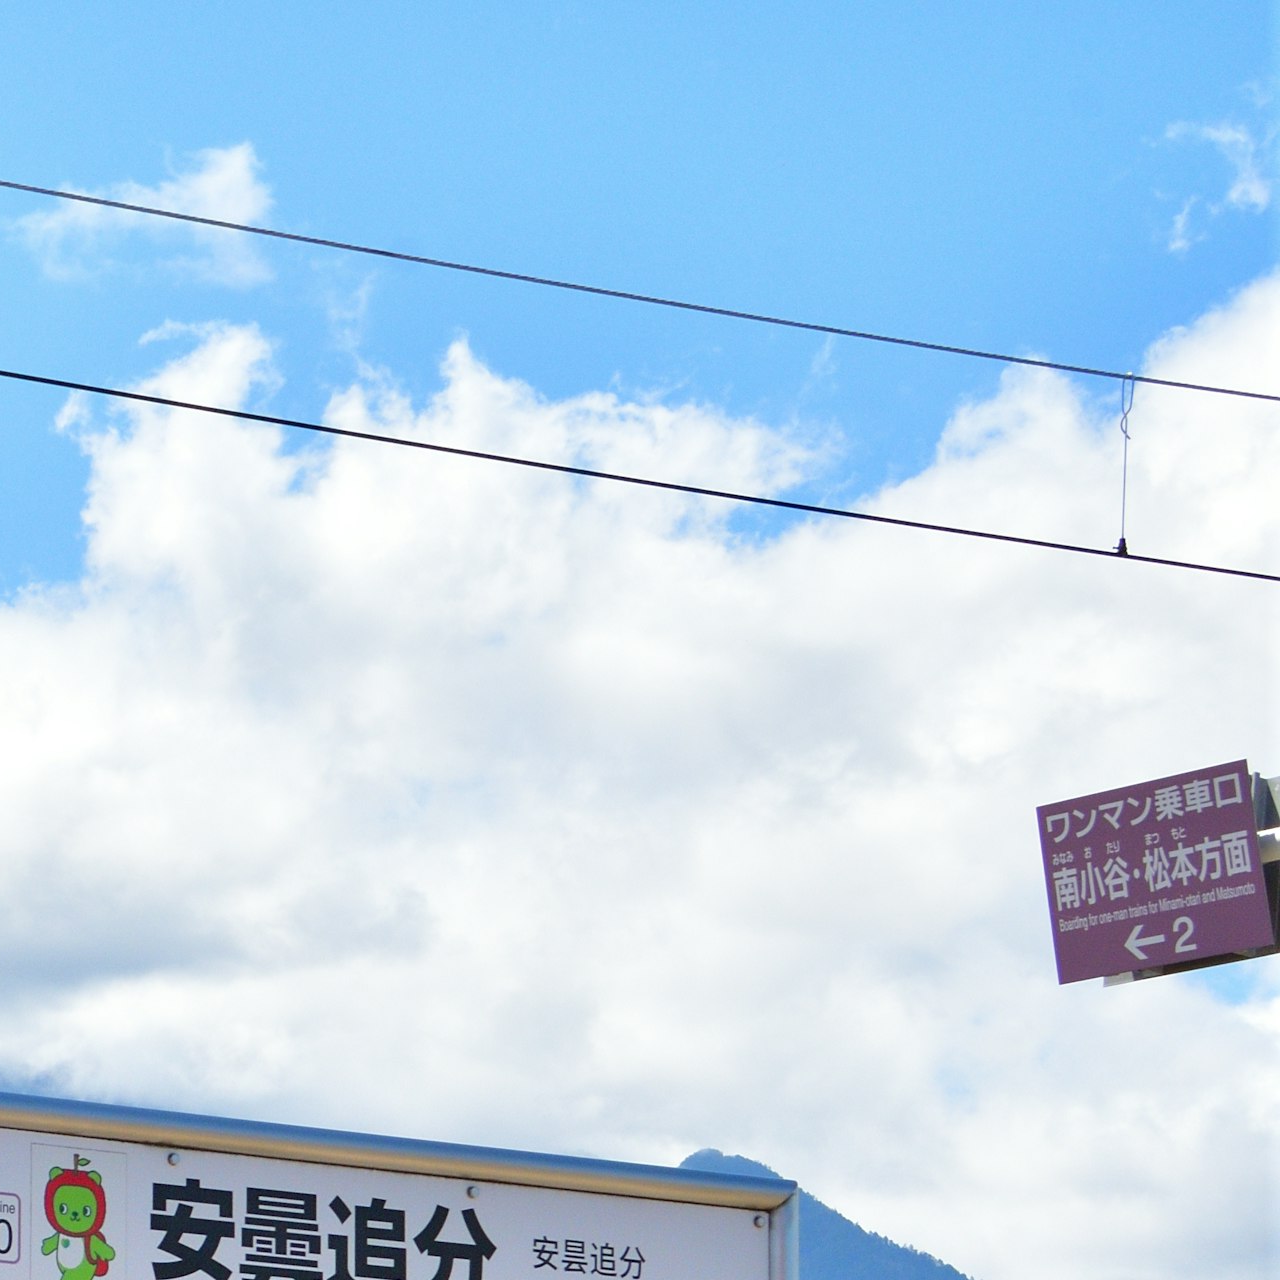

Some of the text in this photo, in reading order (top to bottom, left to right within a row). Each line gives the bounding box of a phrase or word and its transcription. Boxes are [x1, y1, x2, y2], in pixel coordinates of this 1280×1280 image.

[1046, 773, 1242, 843] ワンマン乗車口
[1058, 917, 1089, 933] Boarding
[1098, 908, 1128, 924] one-man
[1128, 902, 1149, 919] trains
[1148, 899, 1160, 915] for
[1201, 889, 1217, 904] and
[1216, 882, 1256, 900] Matsumoto
[1172, 916, 1197, 953] 2
[532, 1235, 646, 1280] 安昙追分
